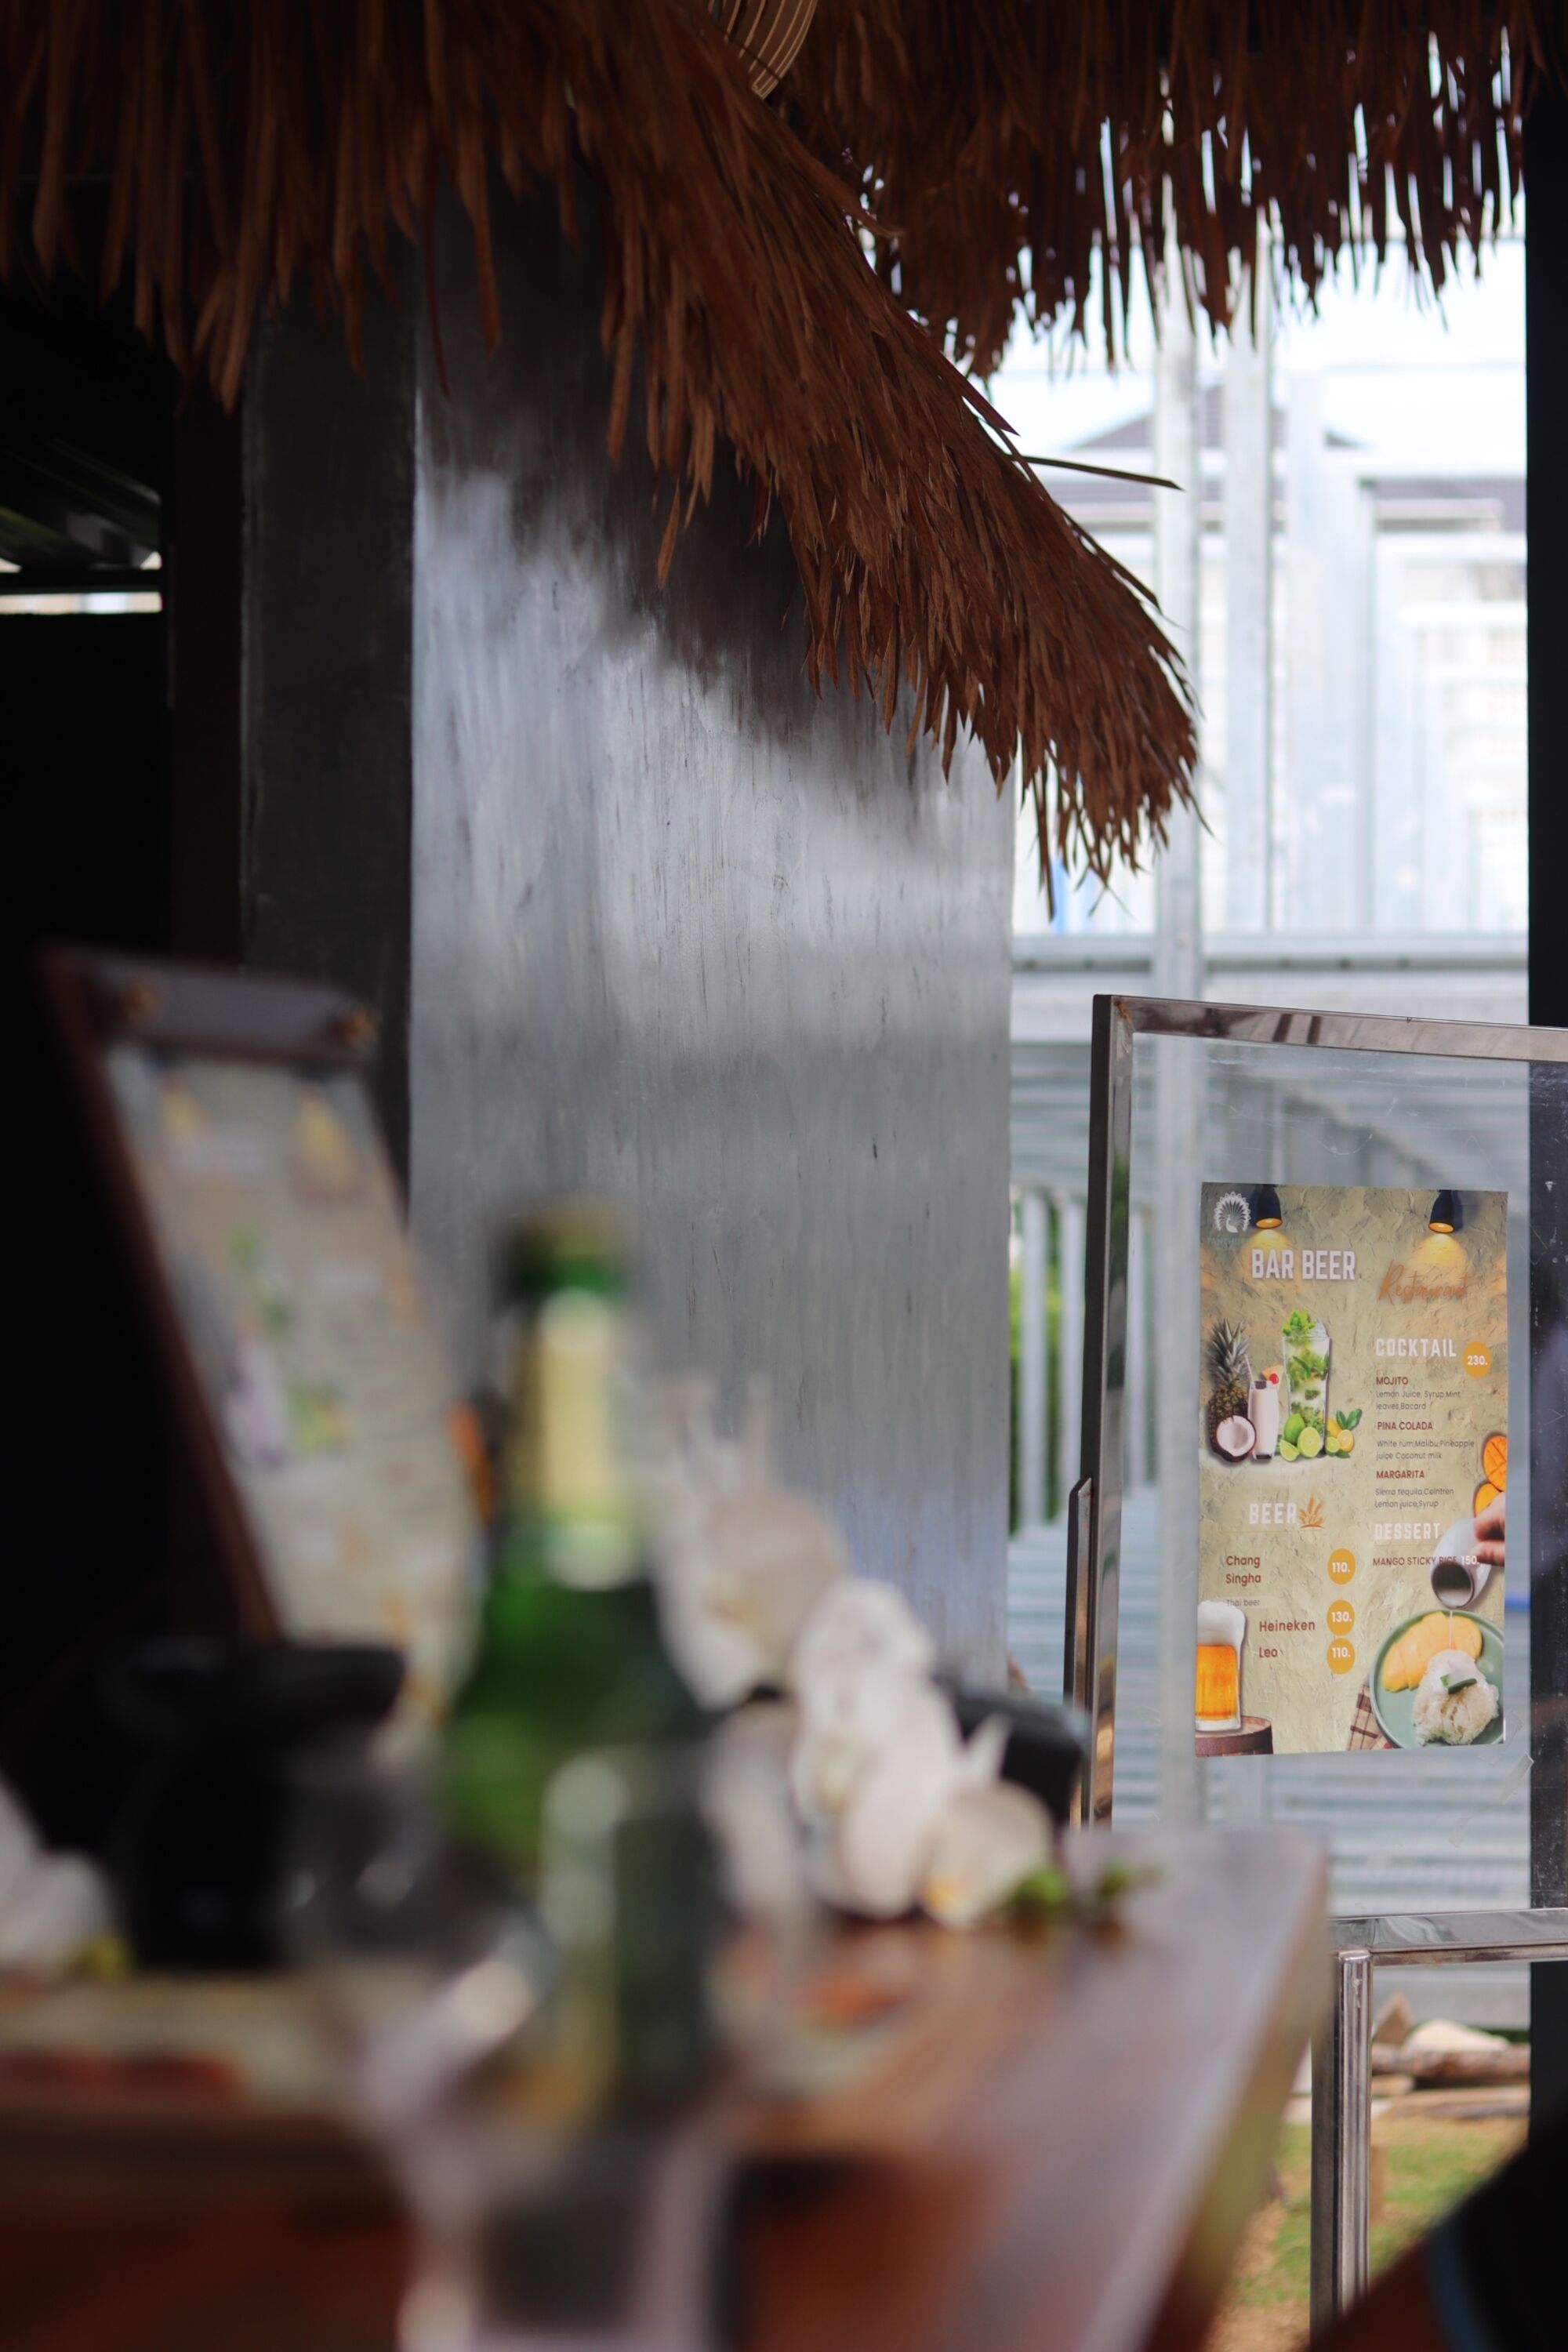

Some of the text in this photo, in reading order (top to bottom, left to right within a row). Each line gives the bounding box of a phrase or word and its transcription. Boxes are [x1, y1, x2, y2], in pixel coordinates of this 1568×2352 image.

[1252, 1248, 1356, 1280] BAR BEER
[1375, 1338, 1457, 1357] COCKTAIL
[1467, 1355, 1488, 1366] 230.
[1399, 1421, 1433, 1430] COLADA
[1376, 1452, 1393, 1461] juice
[1376, 1470, 1425, 1479] MARGARITA
[1249, 1503, 1298, 1524] BEER
[1374, 1523, 1441, 1539] DESSERT
[1226, 1556, 1261, 1568] Chang
[1373, 1557, 1405, 1566] MANGO
[1407, 1557, 1436, 1566] STICKY
[1461, 1555, 1479, 1565] 150.
[1332, 1562, 1350, 1573] 110.
[1225, 1573, 1261, 1587] Singha
[1332, 1612, 1352, 1622] 130.
[1259, 1621, 1316, 1632] Heineken
[1259, 1647, 1278, 1658] Leo
[1332, 1648, 1351, 1658] 110.
